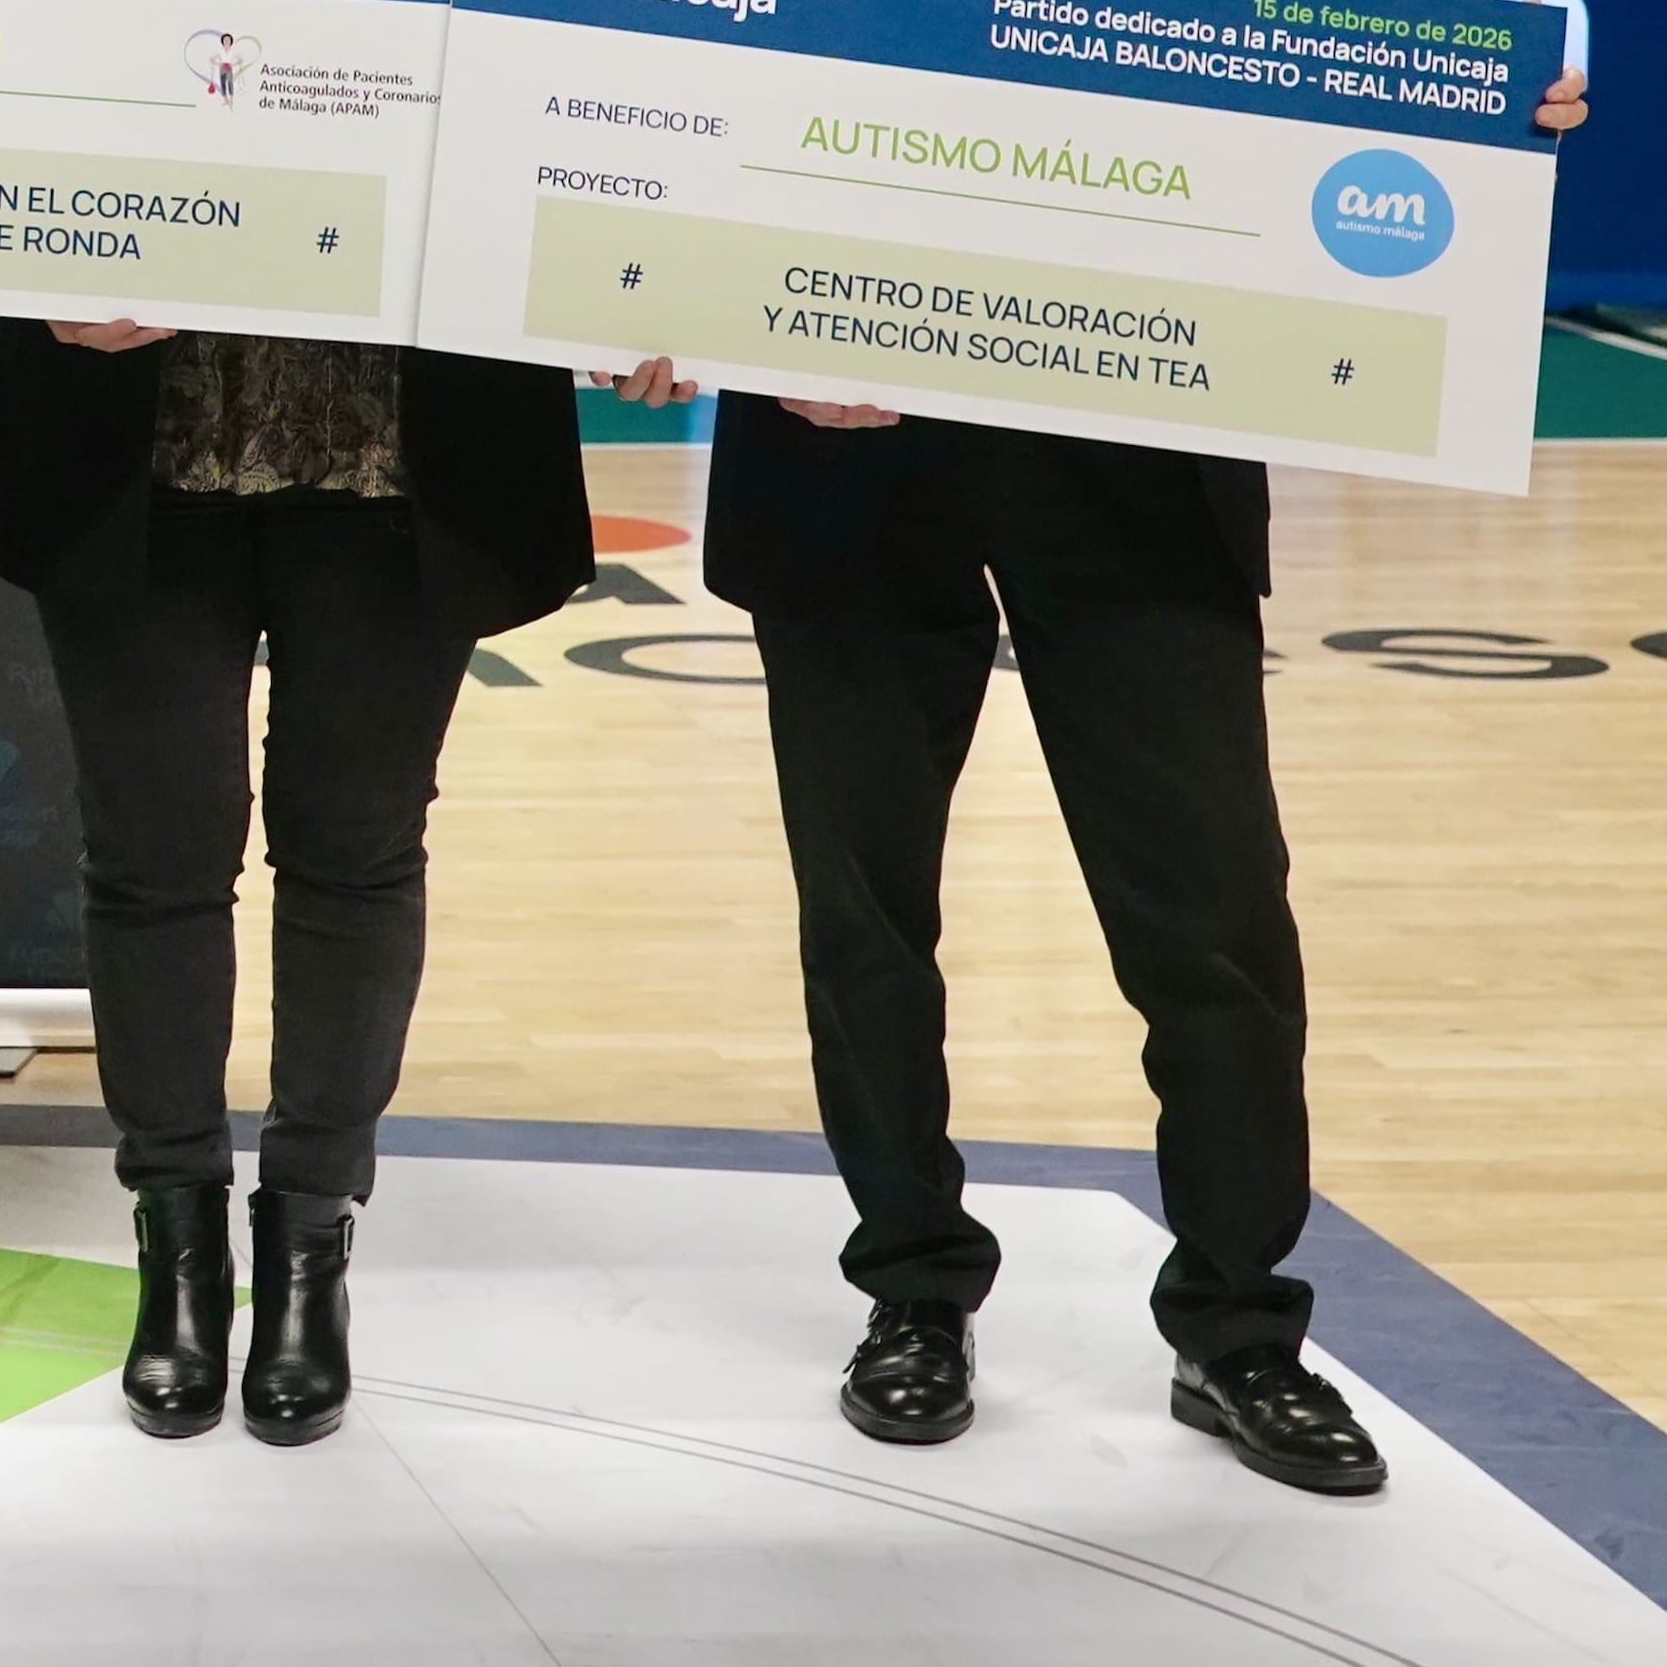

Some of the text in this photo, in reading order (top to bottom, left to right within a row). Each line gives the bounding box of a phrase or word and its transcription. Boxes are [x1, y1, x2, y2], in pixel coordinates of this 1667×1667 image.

[1094, 6, 1215, 42] dedicado
[1221, 27, 1236, 45] a
[1243, 24, 1265, 49] la
[1272, 29, 1405, 68] Fundación
[1413, 48, 1508, 86] Unicaja
[1283, 2, 1313, 24] de
[1320, 5, 1409, 37] febrero
[1415, 20, 1446, 41] de
[1452, 23, 1512, 50] 2026
[259, 63, 413, 86] Asociación de Pacientes
[991, 24, 1506, 114] UNICAJA BALONCESTO REAL MADRID
[258, 79, 360, 99] Anticoagulados
[362, 89, 371, 103] y
[258, 95, 380, 119] de Málaga (APAM)
[545, 96, 727, 137] A BENEFICIO DE:
[801, 117, 1190, 200] AUTISMO MÁLAGA
[537, 166, 667, 200] PROYECTO:
[28, 186, 64, 214] EL
[71, 190, 239, 227] CORAZÓN
[1337, 185, 1425, 225] am
[23, 226, 140, 259] RONDA
[1335, 220, 1425, 242] autismo málaga
[785, 267, 1195, 346] CENTRO DE VALORACIÓN
[764, 305, 1209, 390] Y ATENCIÓN SOCIAL EN TEA
